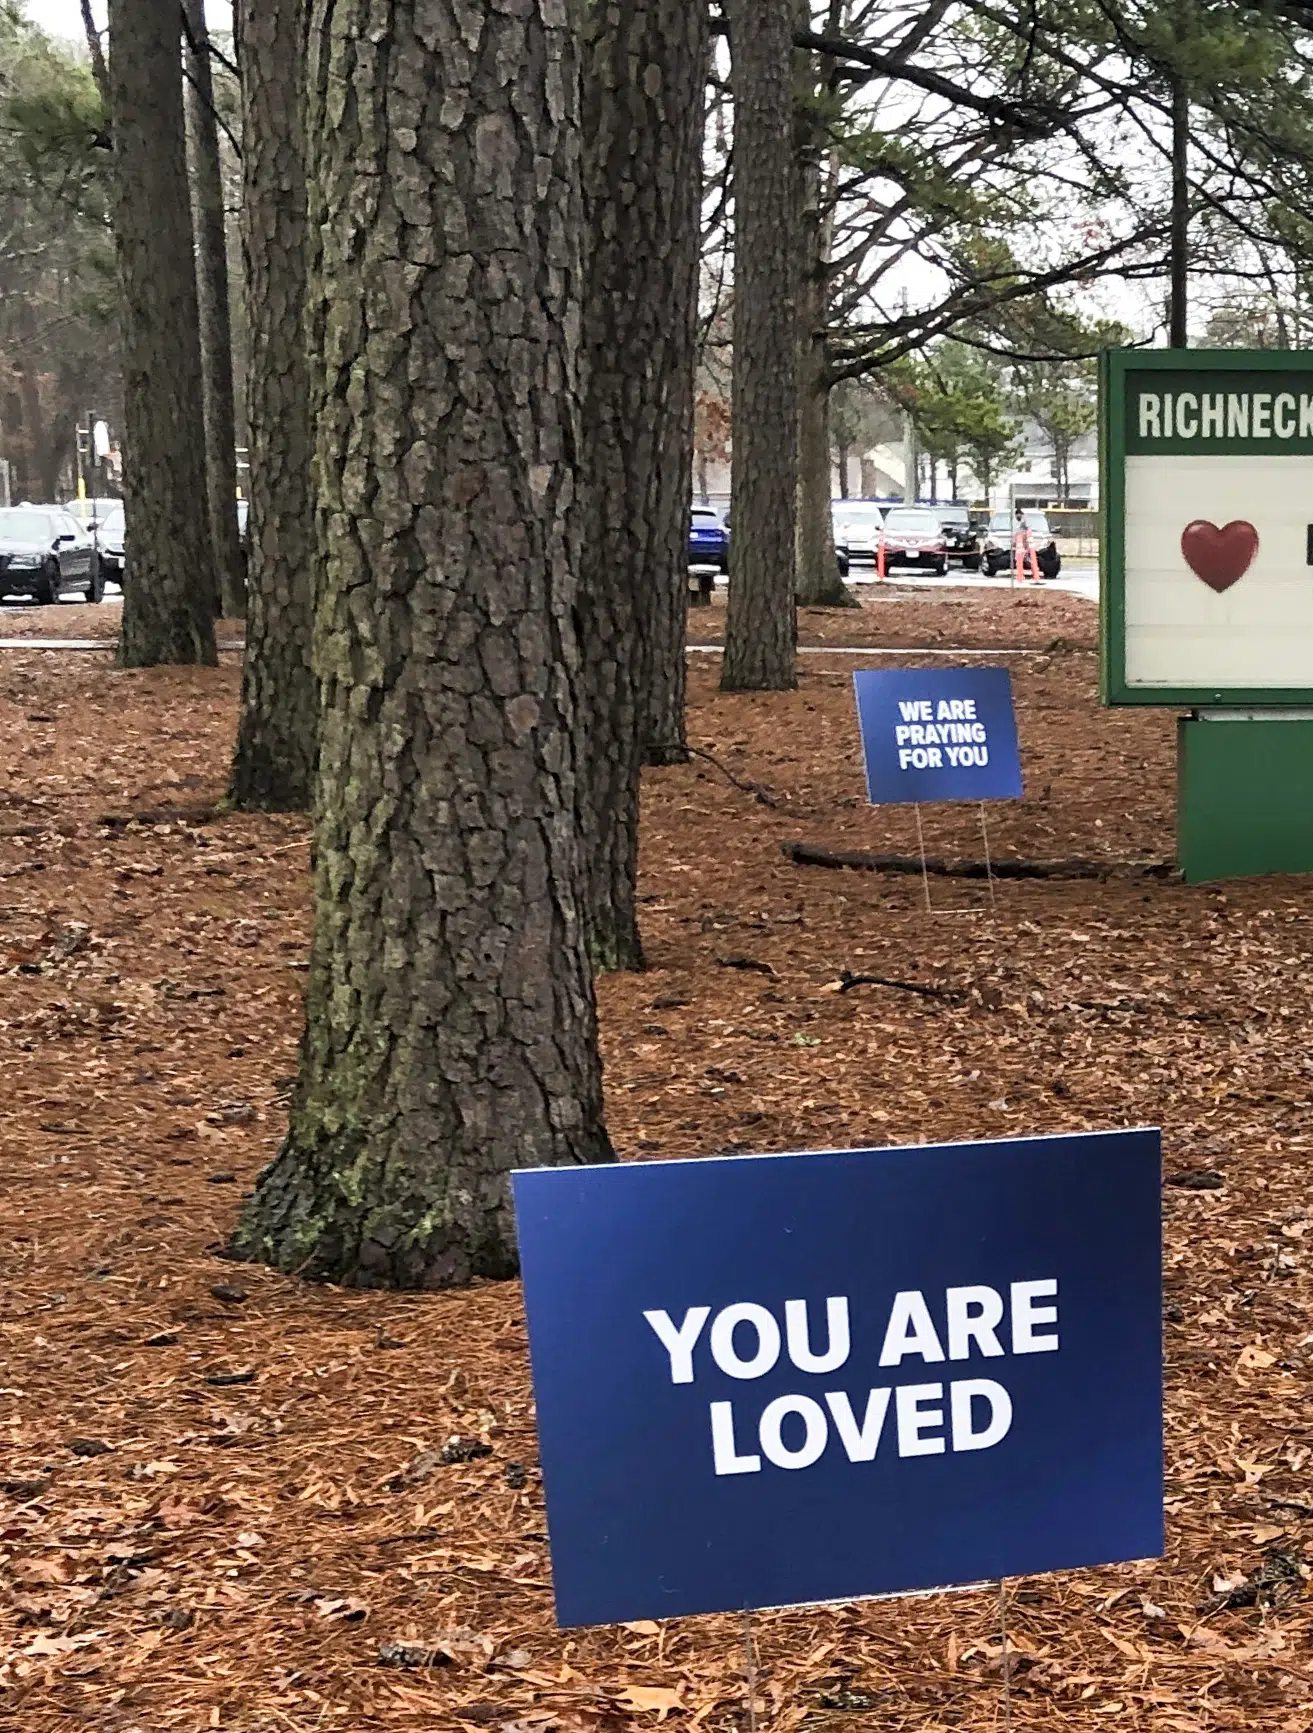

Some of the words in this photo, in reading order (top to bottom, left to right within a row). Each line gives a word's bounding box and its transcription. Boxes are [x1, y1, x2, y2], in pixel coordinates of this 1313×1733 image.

[898, 701, 933, 722] WE
[936, 699, 977, 721] ARE
[895, 722, 987, 746] PRAYING
[898, 748, 944, 770] FOR
[944, 746, 989, 767] YOU
[643, 1296, 851, 1384] YOU
[879, 1279, 1060, 1367] ARE
[710, 1378, 1013, 1475] LOVED
